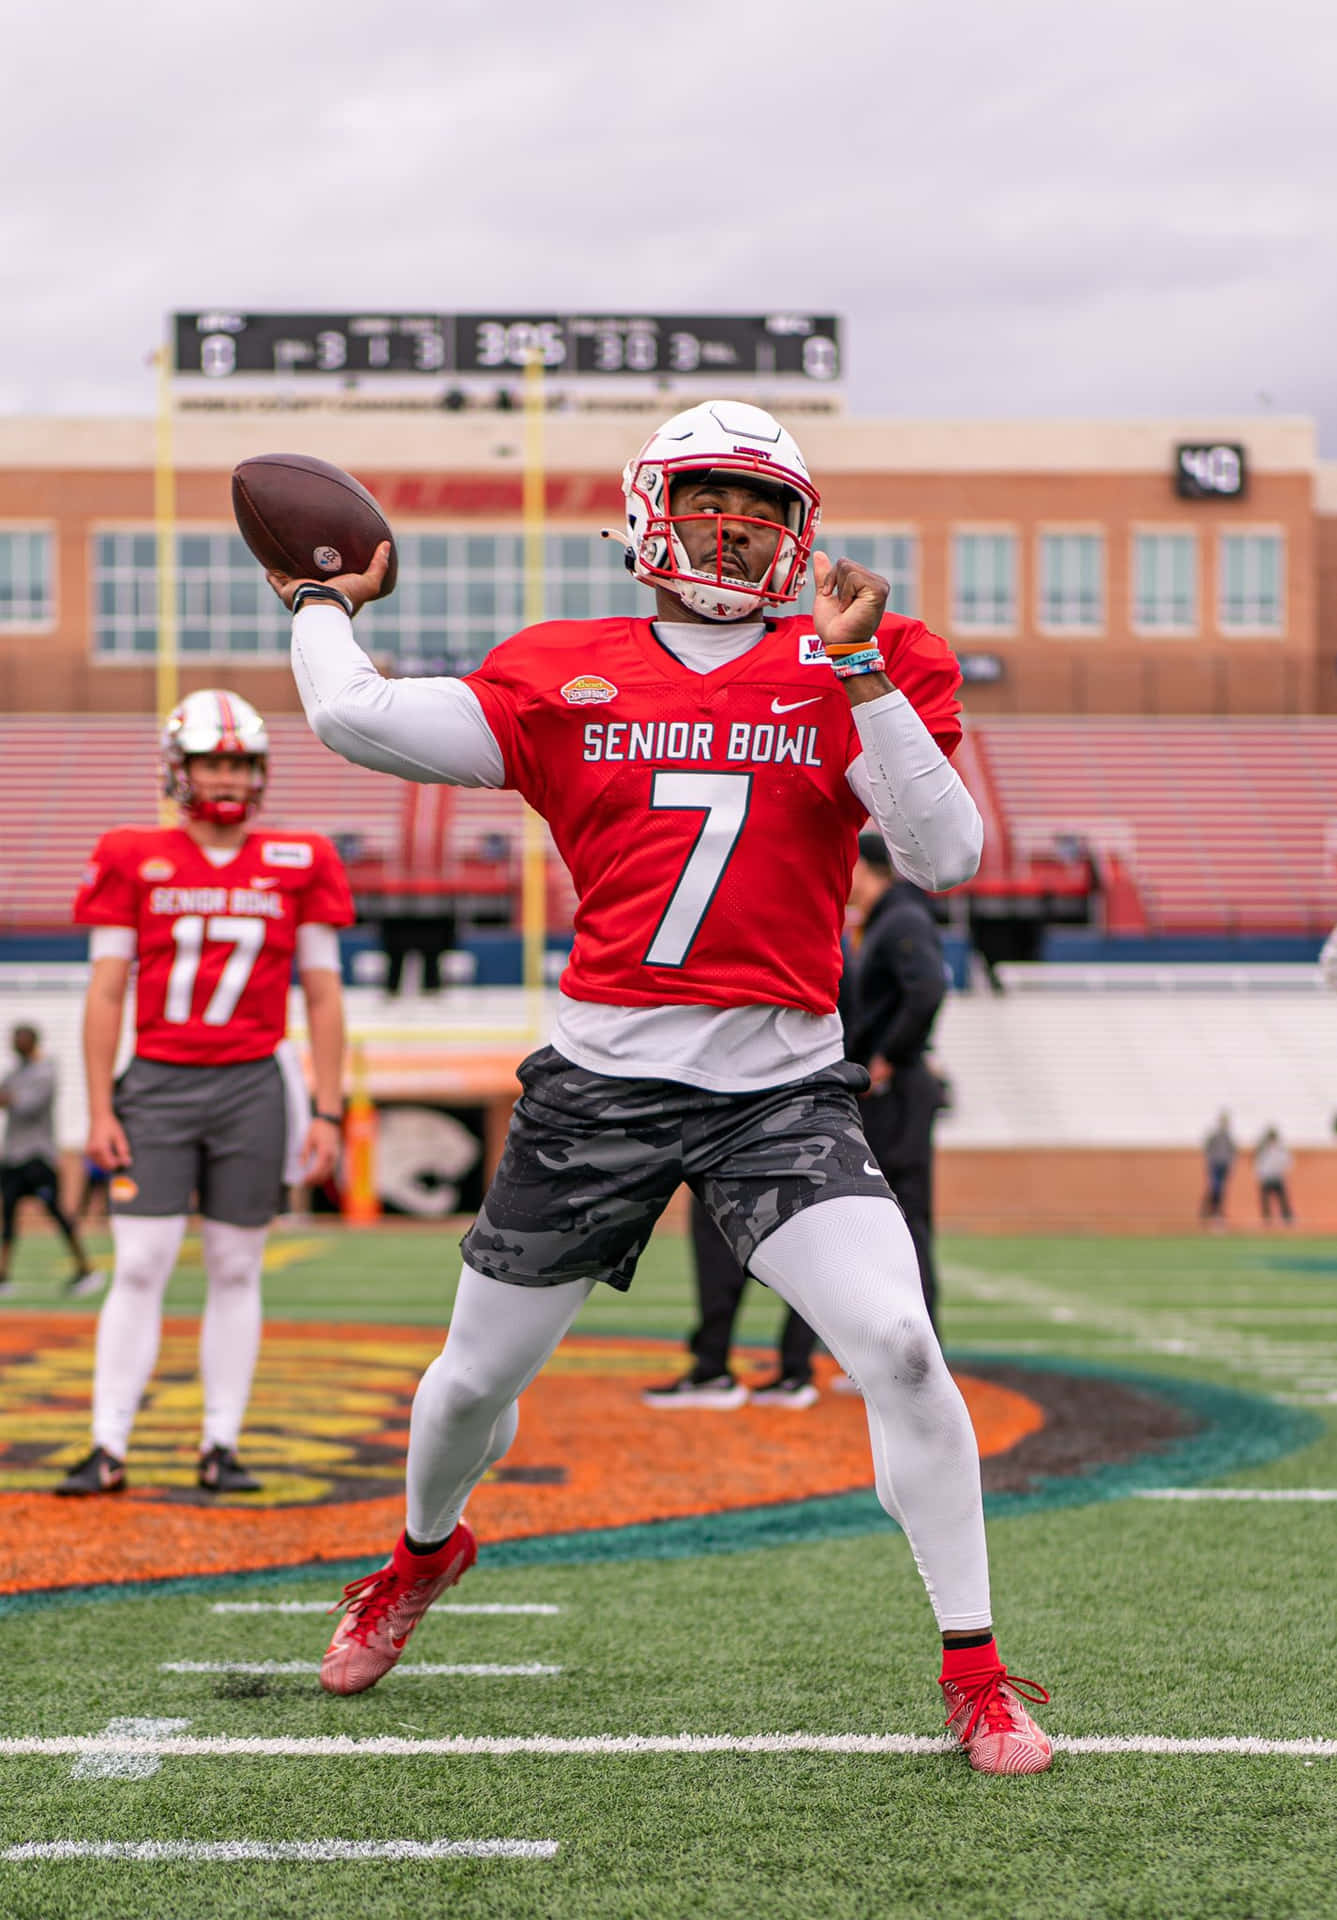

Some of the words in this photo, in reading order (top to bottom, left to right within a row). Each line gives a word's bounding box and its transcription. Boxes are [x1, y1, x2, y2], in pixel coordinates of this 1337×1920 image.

[582, 721, 714, 762] SENIOR
[726, 722, 823, 767] BOWL
[641, 769, 754, 968] 7
[164, 915, 266, 1026] 17
